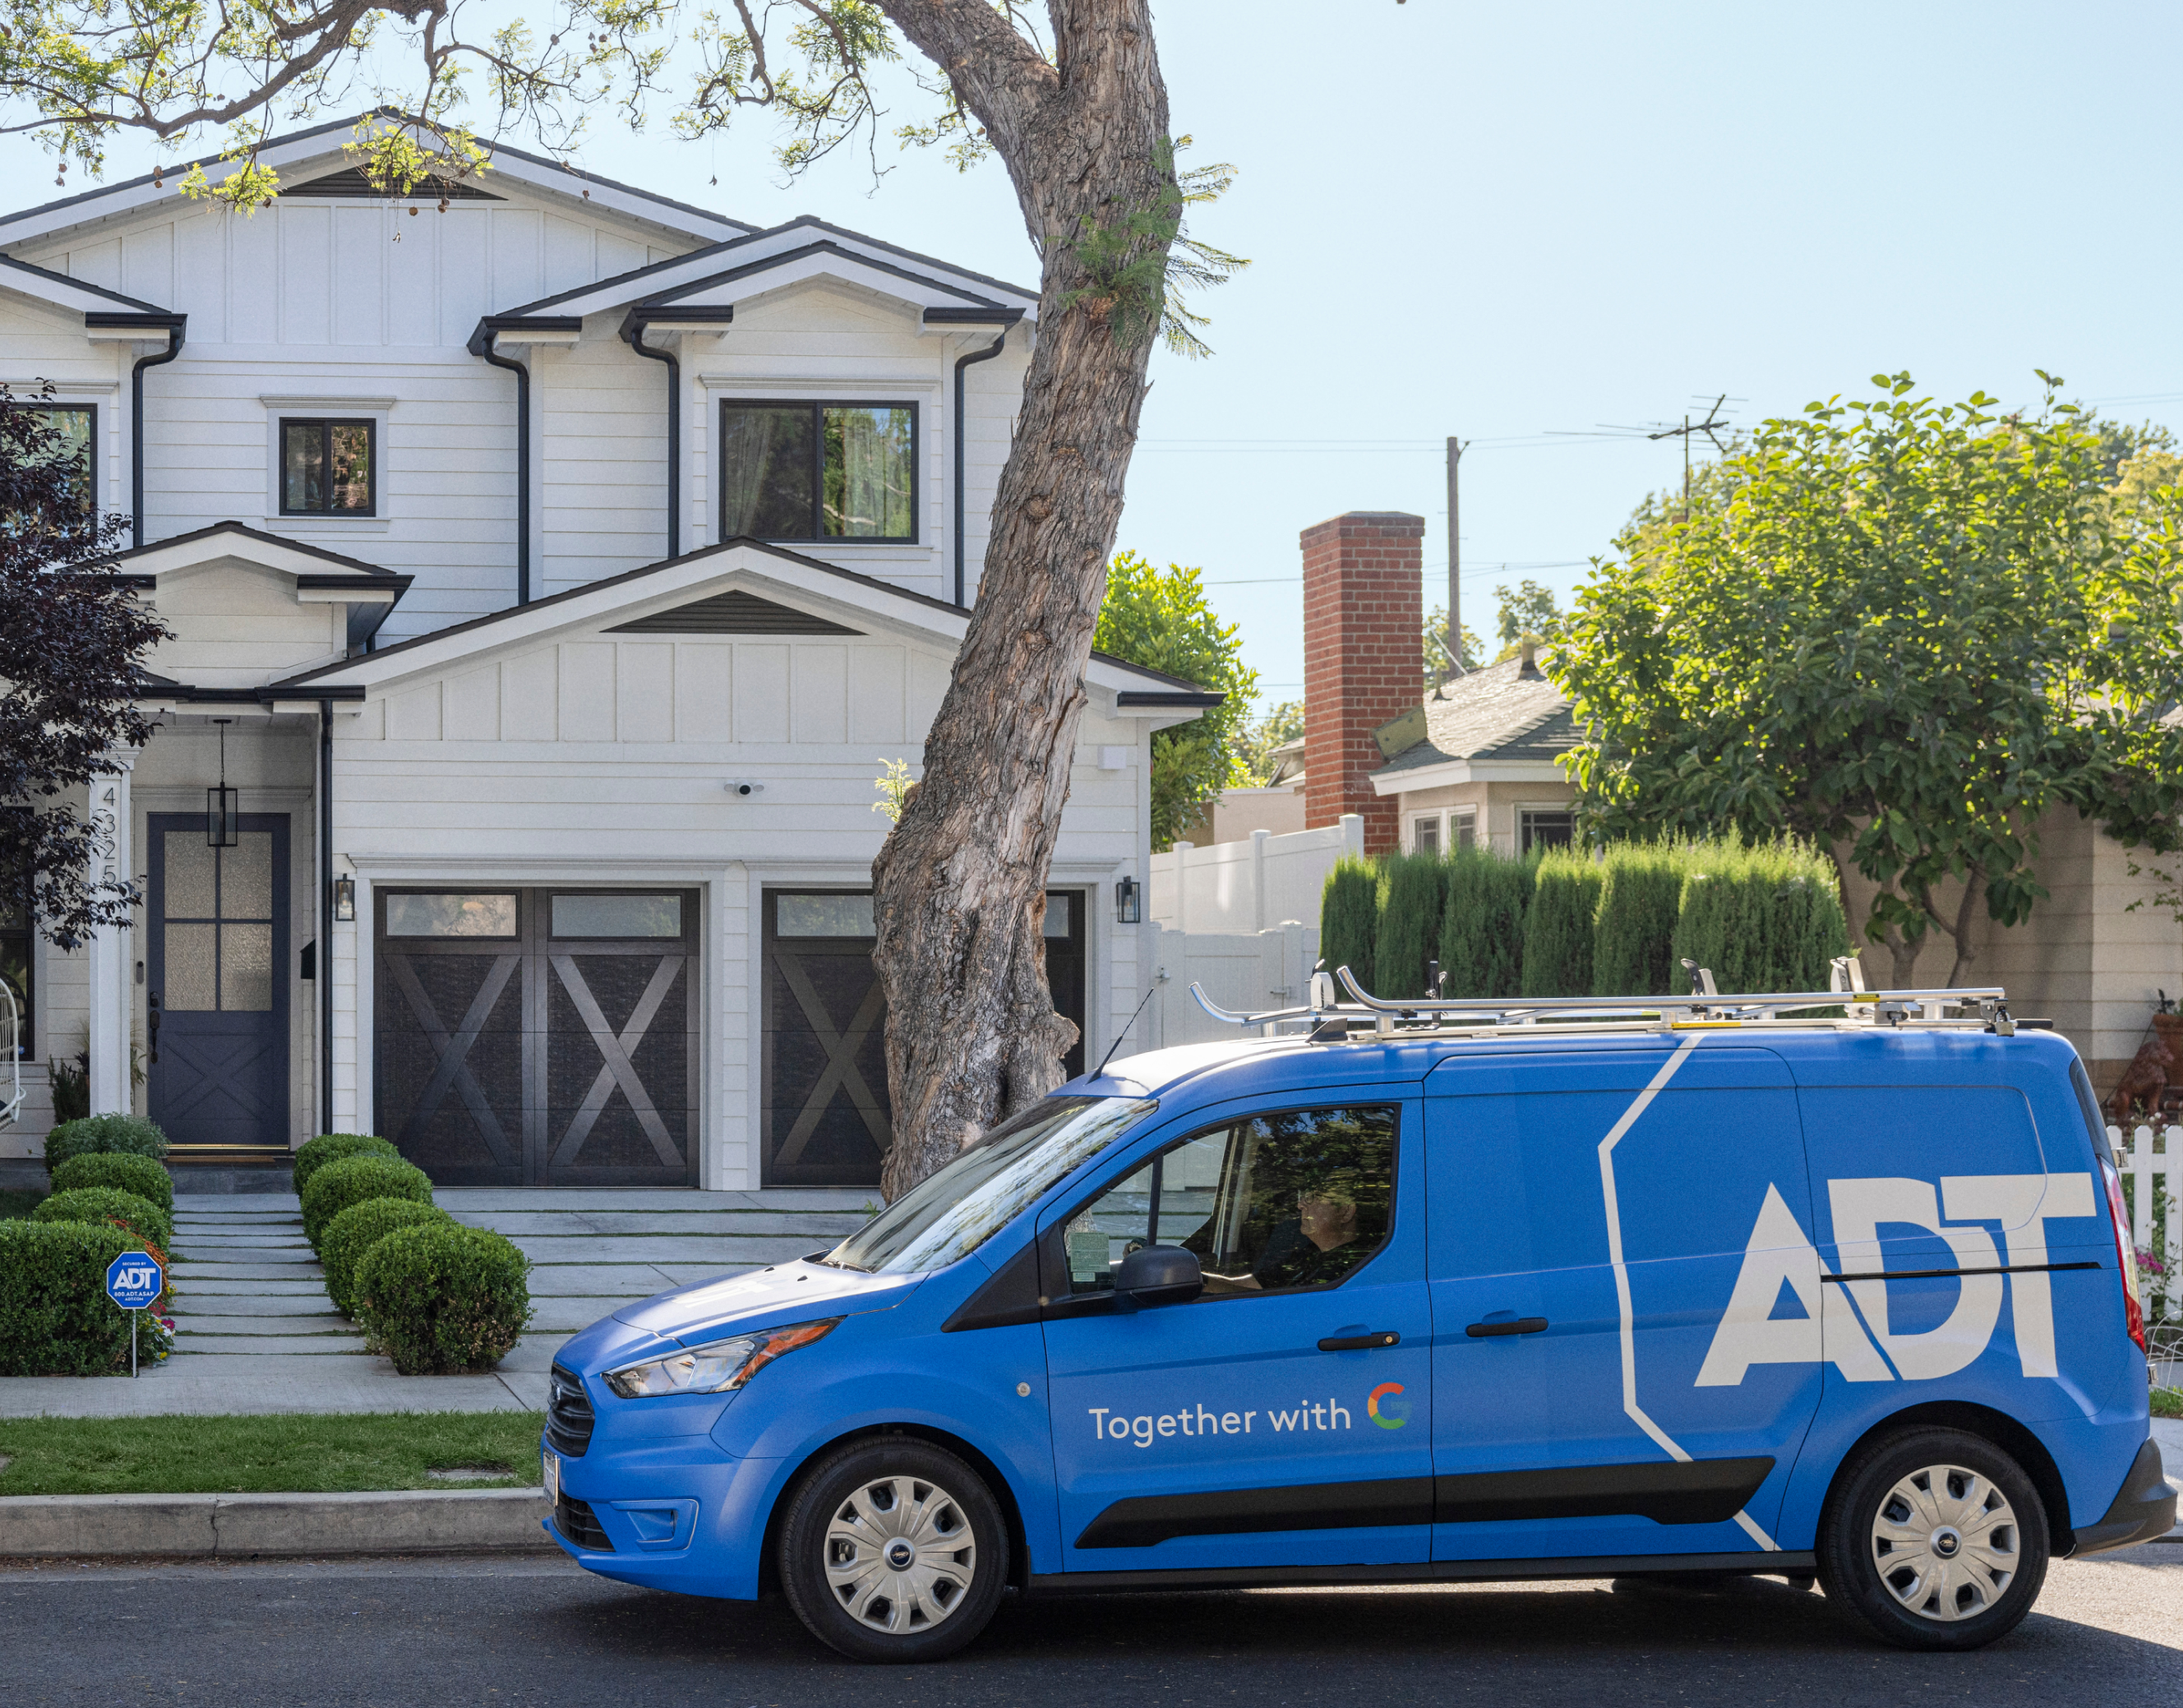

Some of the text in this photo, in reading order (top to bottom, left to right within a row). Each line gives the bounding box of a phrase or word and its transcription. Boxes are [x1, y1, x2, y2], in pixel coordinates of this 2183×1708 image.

[103, 787, 117, 885] 4325
[113, 1267, 156, 1290] ADT
[1693, 1172, 2098, 1387] ADT
[1088, 1403, 1258, 1448] Together
[1267, 1398, 1352, 1432] with
